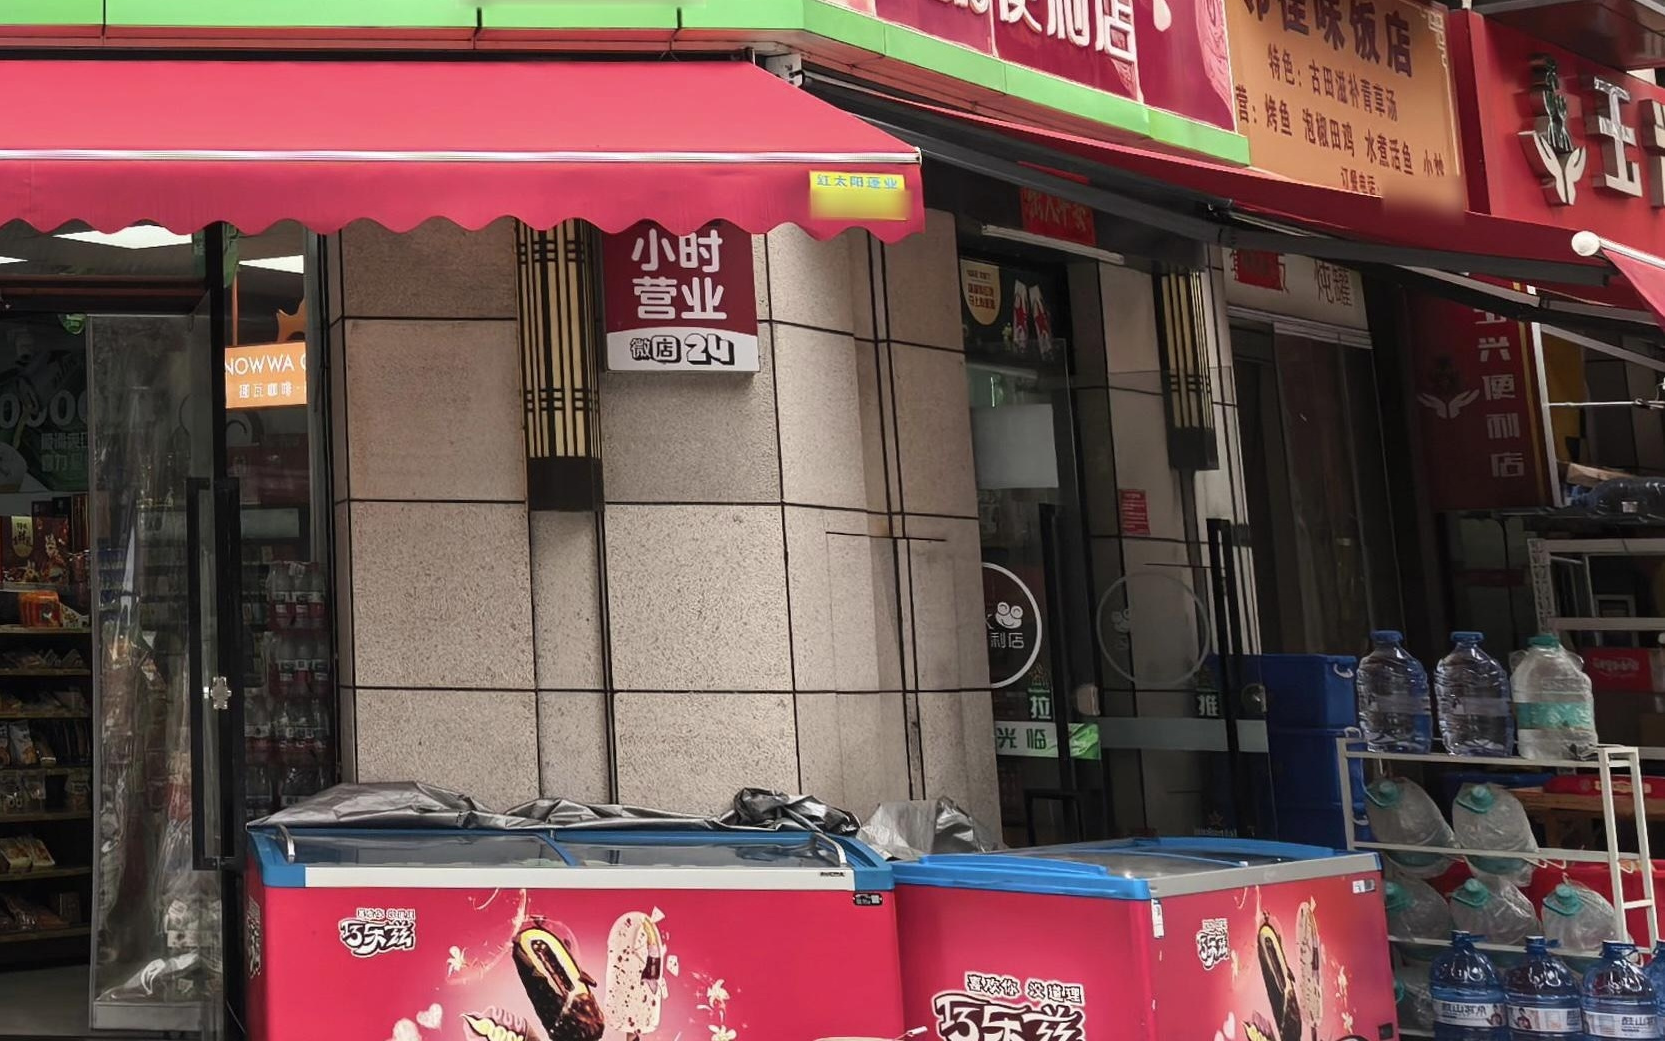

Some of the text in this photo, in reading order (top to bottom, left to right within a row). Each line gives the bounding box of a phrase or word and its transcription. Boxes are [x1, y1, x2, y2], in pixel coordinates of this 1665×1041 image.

[631, 227, 724, 273] 小时
[631, 275, 728, 321] 营业
[630, 332, 735, 366] 微店 24
[225, 353, 295, 376] NOWWA
[1030, 696, 1052, 720] 拉
[1197, 694, 1220, 717] 推
[996, 726, 1048, 750] 光临
[339, 919, 415, 958] 巧乐兹
[966, 973, 1020, 996] 喜欢你
